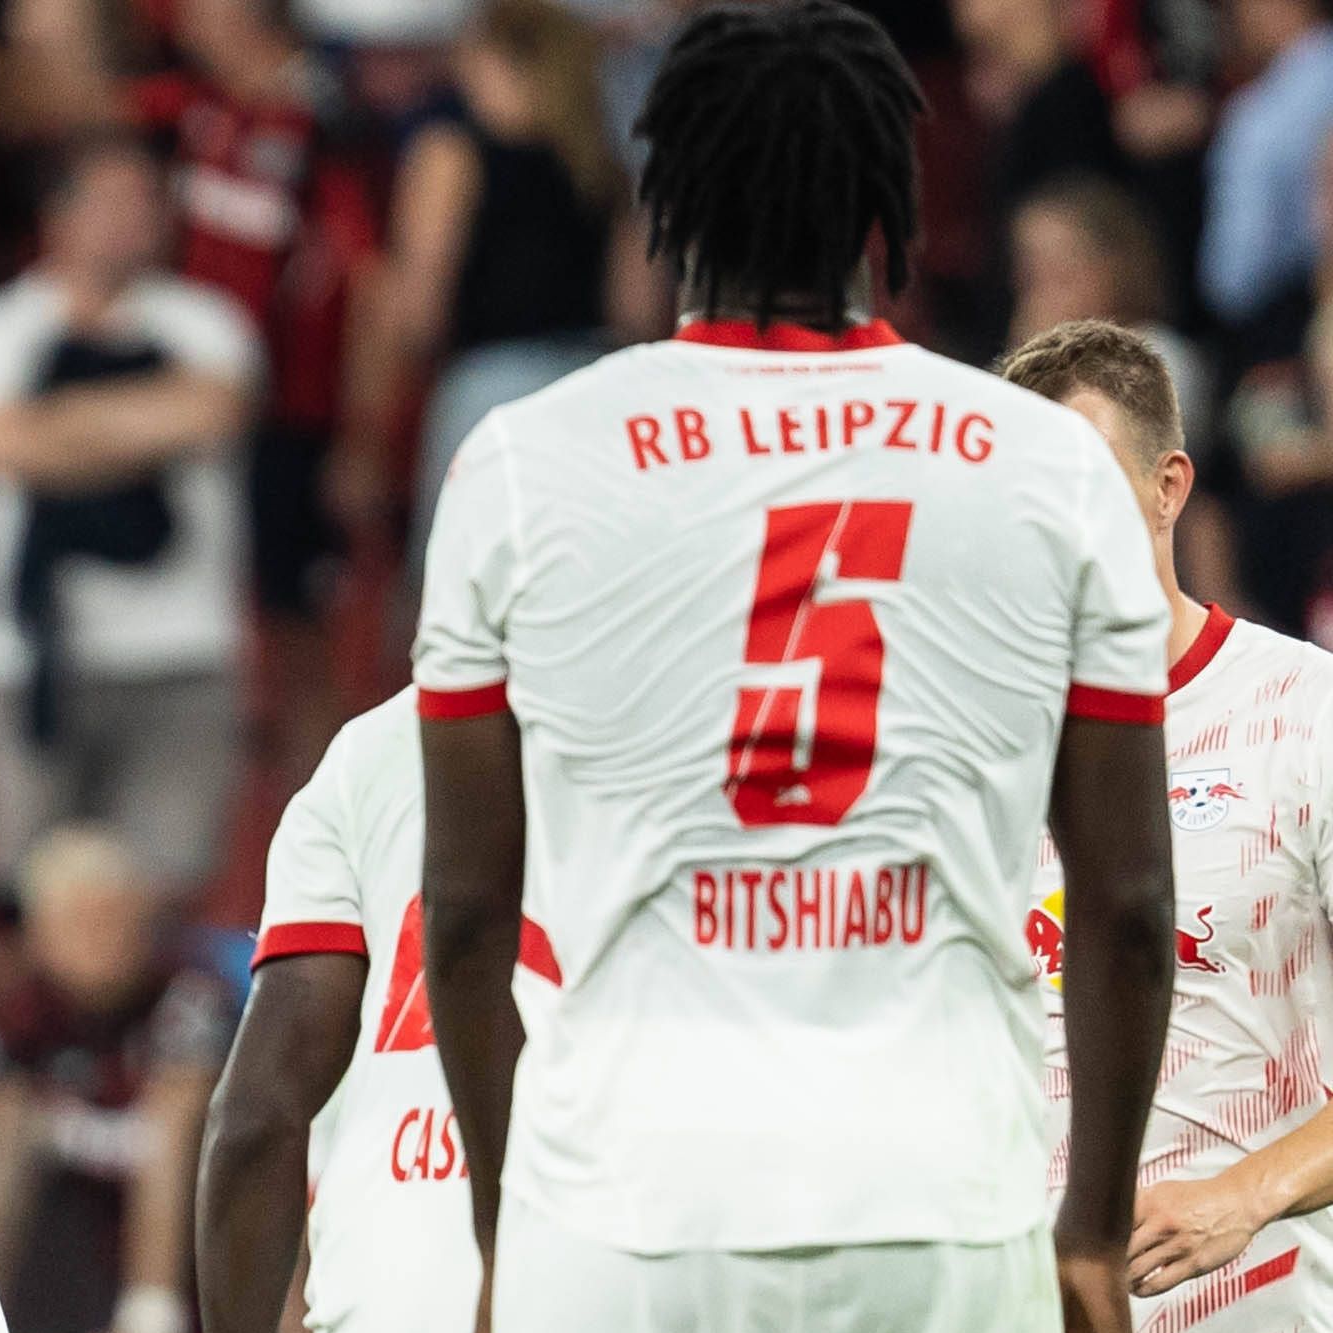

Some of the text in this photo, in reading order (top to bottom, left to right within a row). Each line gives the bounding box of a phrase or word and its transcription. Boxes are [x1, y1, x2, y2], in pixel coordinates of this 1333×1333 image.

[626, 400, 994, 471] RB LEIPZIG
[723, 498, 914, 827] 5
[694, 863, 928, 949] BITSHIABU
[391, 1107, 471, 1183] CAS
